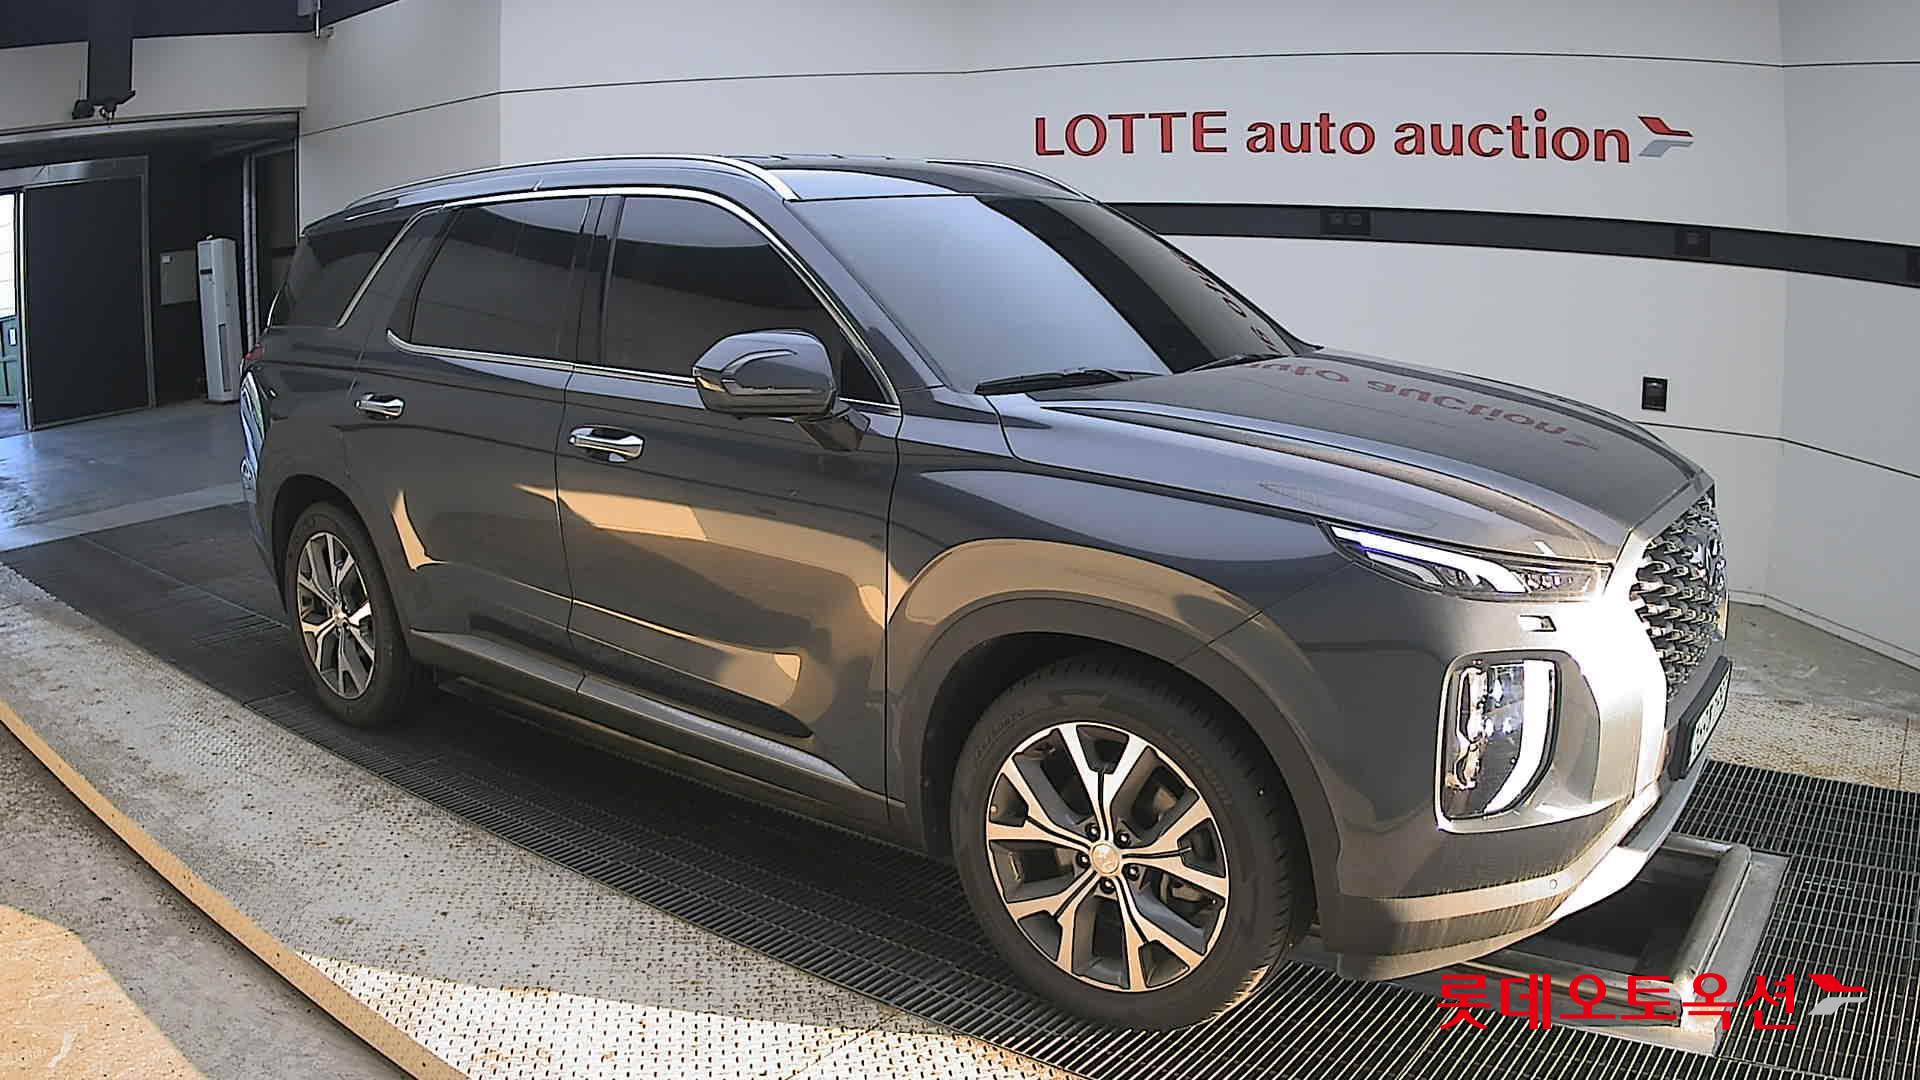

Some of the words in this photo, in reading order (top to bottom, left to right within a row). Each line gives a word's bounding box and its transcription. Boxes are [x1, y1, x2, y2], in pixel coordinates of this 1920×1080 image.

[1035, 112, 1228, 156] LOTTE
[1246, 112, 1376, 155] auto
[1394, 108, 1630, 163] auction
